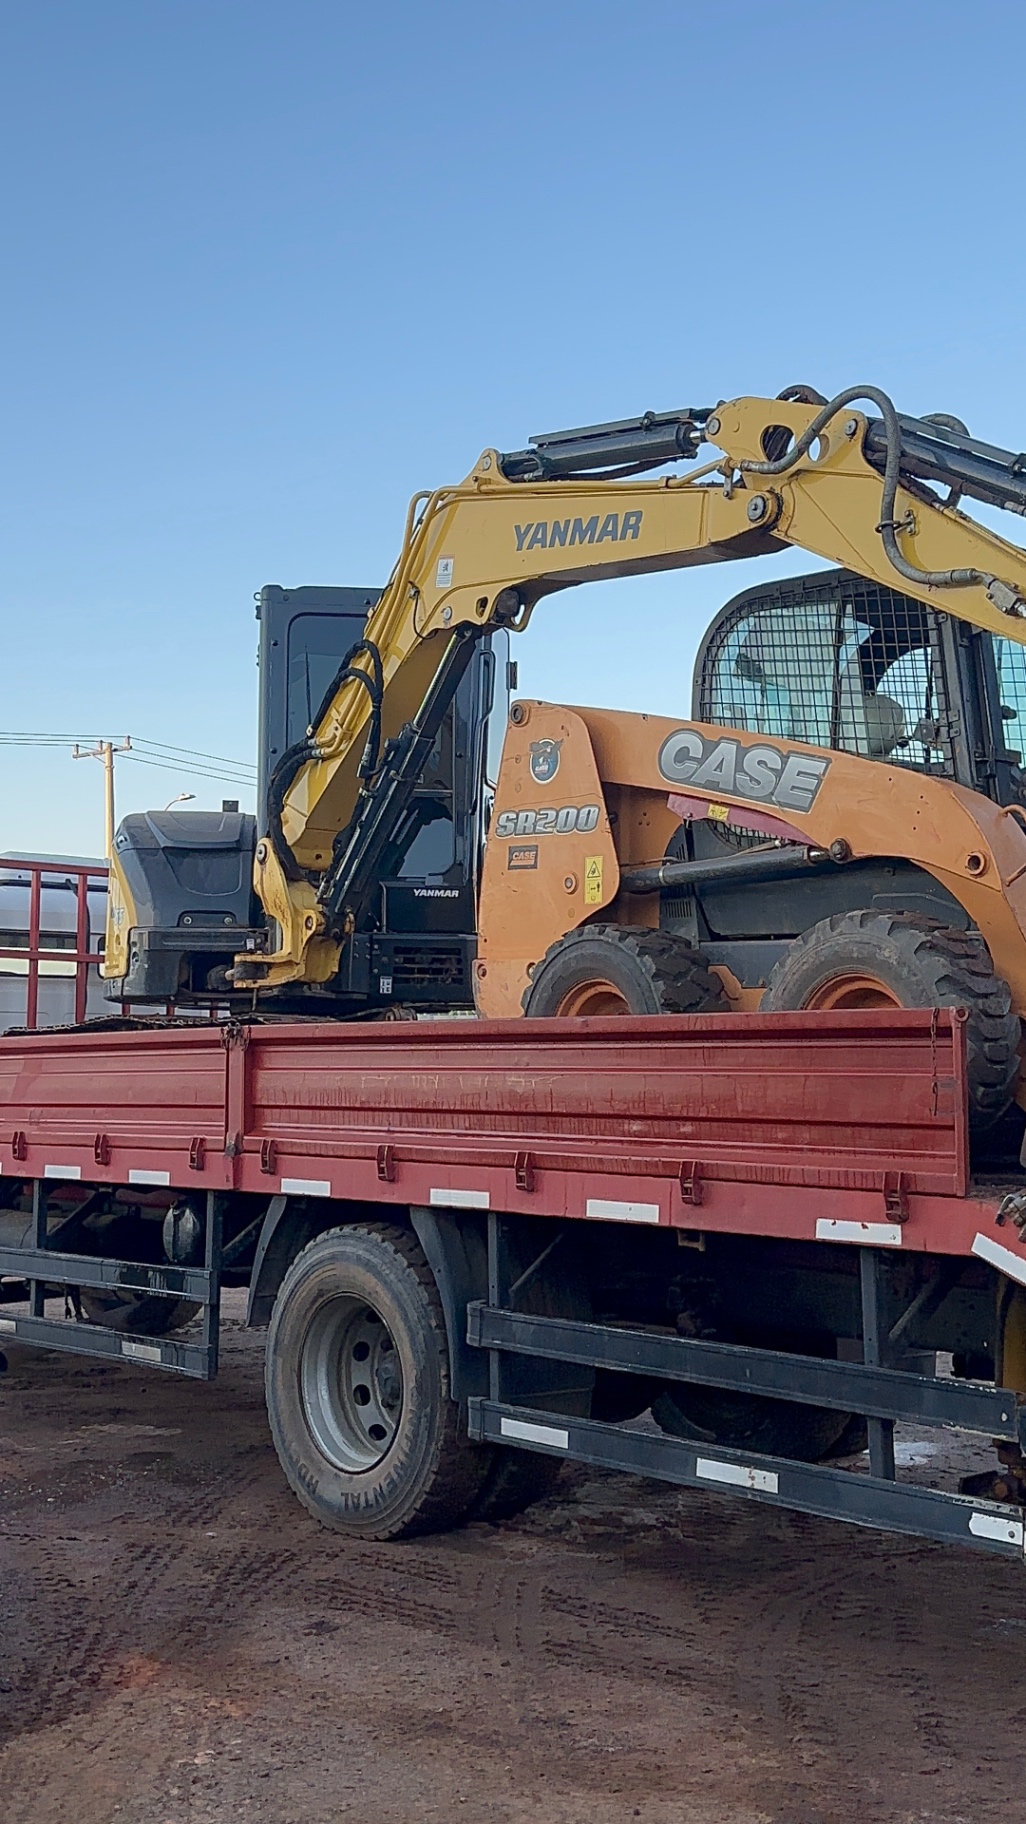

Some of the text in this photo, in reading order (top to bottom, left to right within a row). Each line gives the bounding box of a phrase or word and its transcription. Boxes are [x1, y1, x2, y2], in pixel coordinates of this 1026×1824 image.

[513, 509, 643, 552] YANMAR
[659, 731, 830, 811] CASE
[496, 804, 600, 838] SR200
[512, 851, 536, 860] CASE
[413, 888, 459, 898] YANMAR
